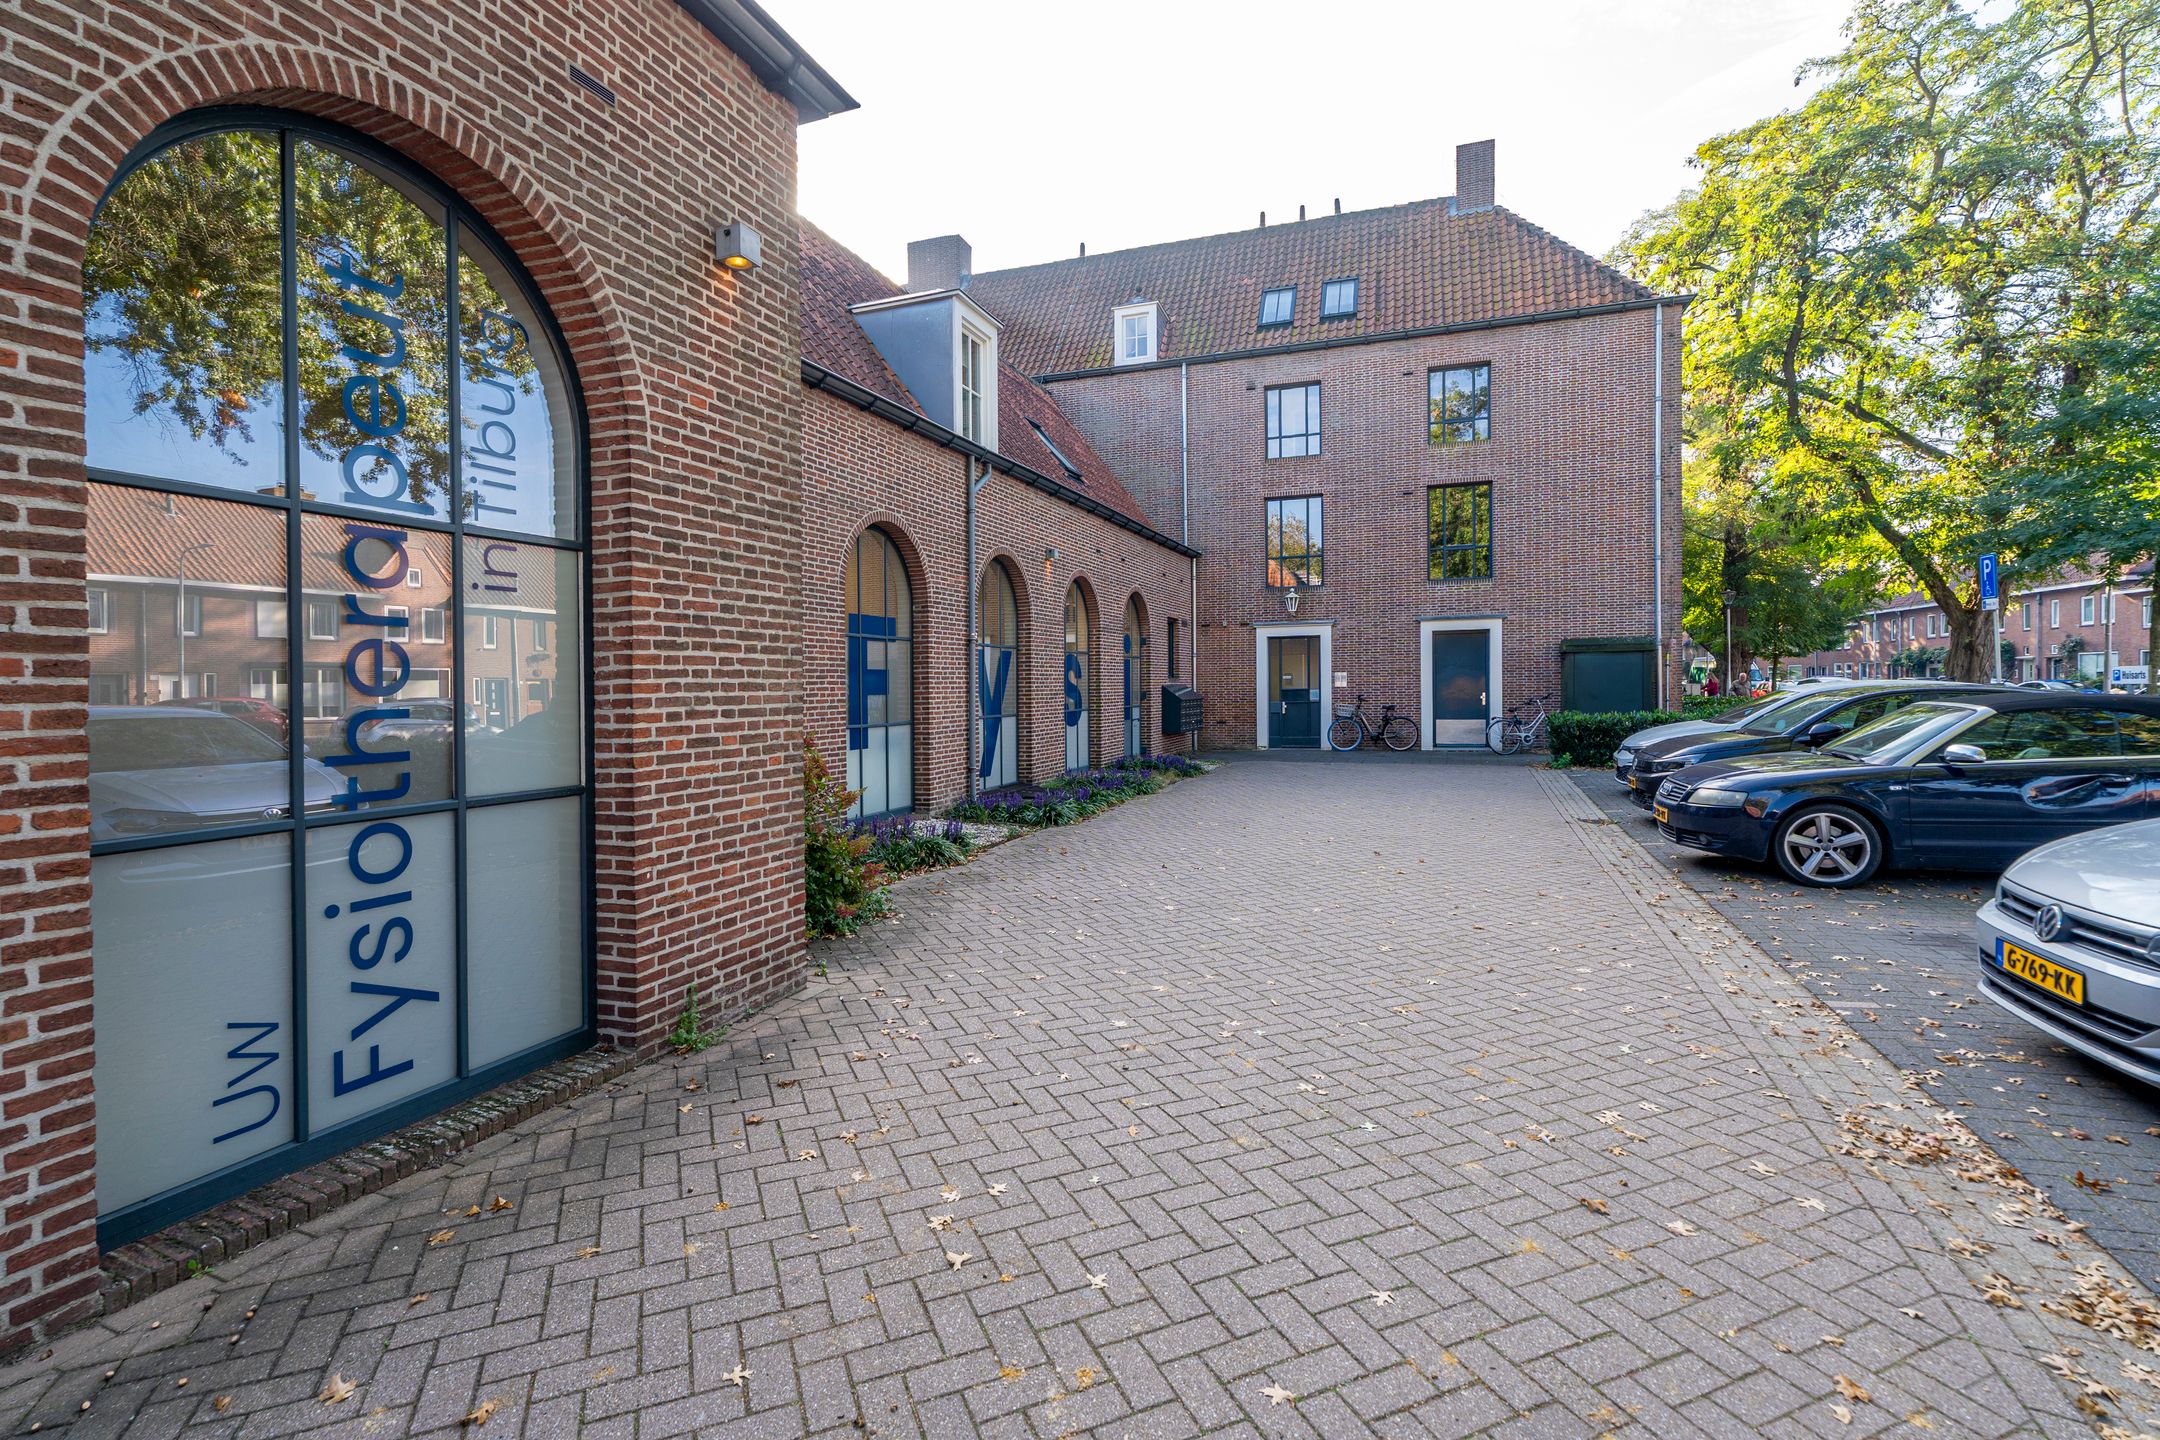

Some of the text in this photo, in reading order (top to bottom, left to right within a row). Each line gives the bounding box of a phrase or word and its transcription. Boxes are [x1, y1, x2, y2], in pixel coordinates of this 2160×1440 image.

[470, 312, 530, 592] in Tilburg
[1983, 559, 1991, 580] P
[324, 254, 439, 1097] Fysiotherapeut
[2121, 670, 2146, 679] Huisarts
[2007, 948, 2076, 998] G-769-KK
